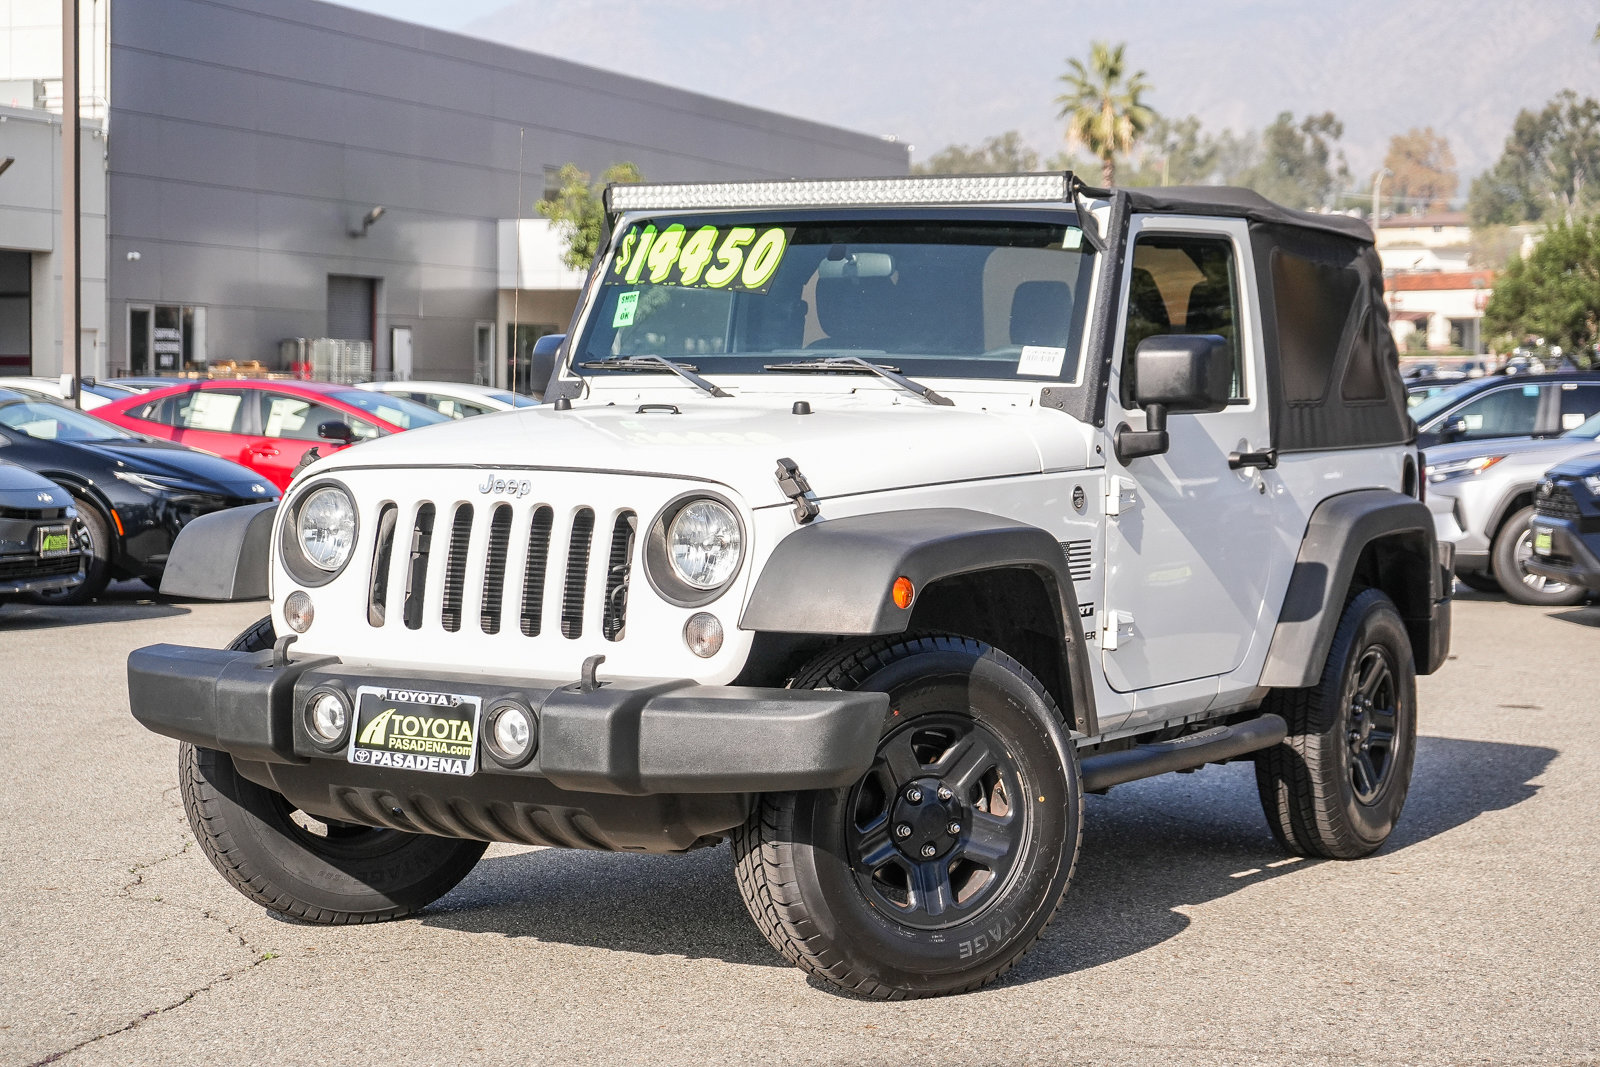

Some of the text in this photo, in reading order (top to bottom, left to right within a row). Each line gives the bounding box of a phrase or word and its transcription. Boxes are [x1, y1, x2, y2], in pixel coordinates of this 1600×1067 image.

[614, 223, 787, 289] $14450
[619, 312, 630, 320] OK
[479, 473, 532, 499] Jeep
[388, 690, 449, 706] TOYOTA
[391, 714, 473, 741] TOYOTA
[388, 738, 472, 756] PASADENA.com
[370, 751, 465, 775] PASADENA
